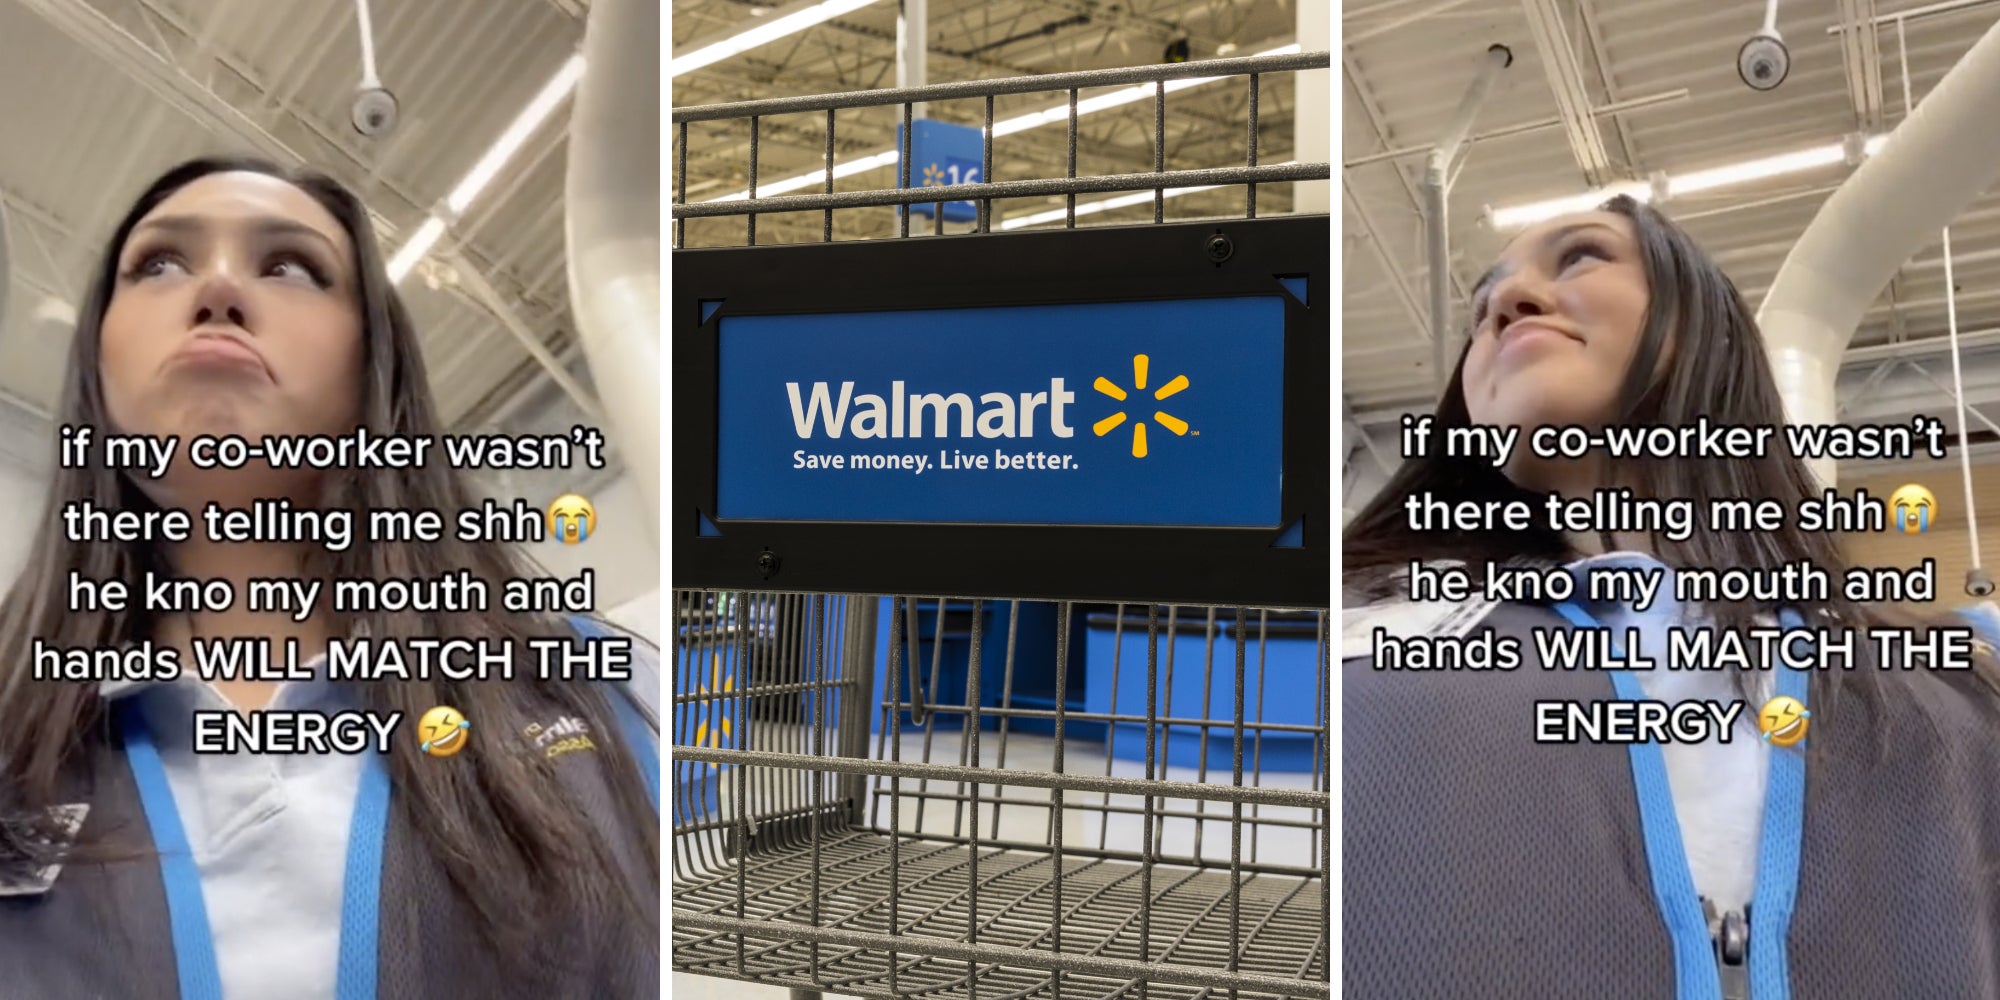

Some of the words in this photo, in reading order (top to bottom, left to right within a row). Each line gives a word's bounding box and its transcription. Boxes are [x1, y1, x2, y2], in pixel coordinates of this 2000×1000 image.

[786, 378, 1075, 439] Walmart
[793, 449, 845, 470] Save
[850, 453, 933, 475] money.
[940, 449, 989, 470] Live
[995, 449, 1079, 470] better.
